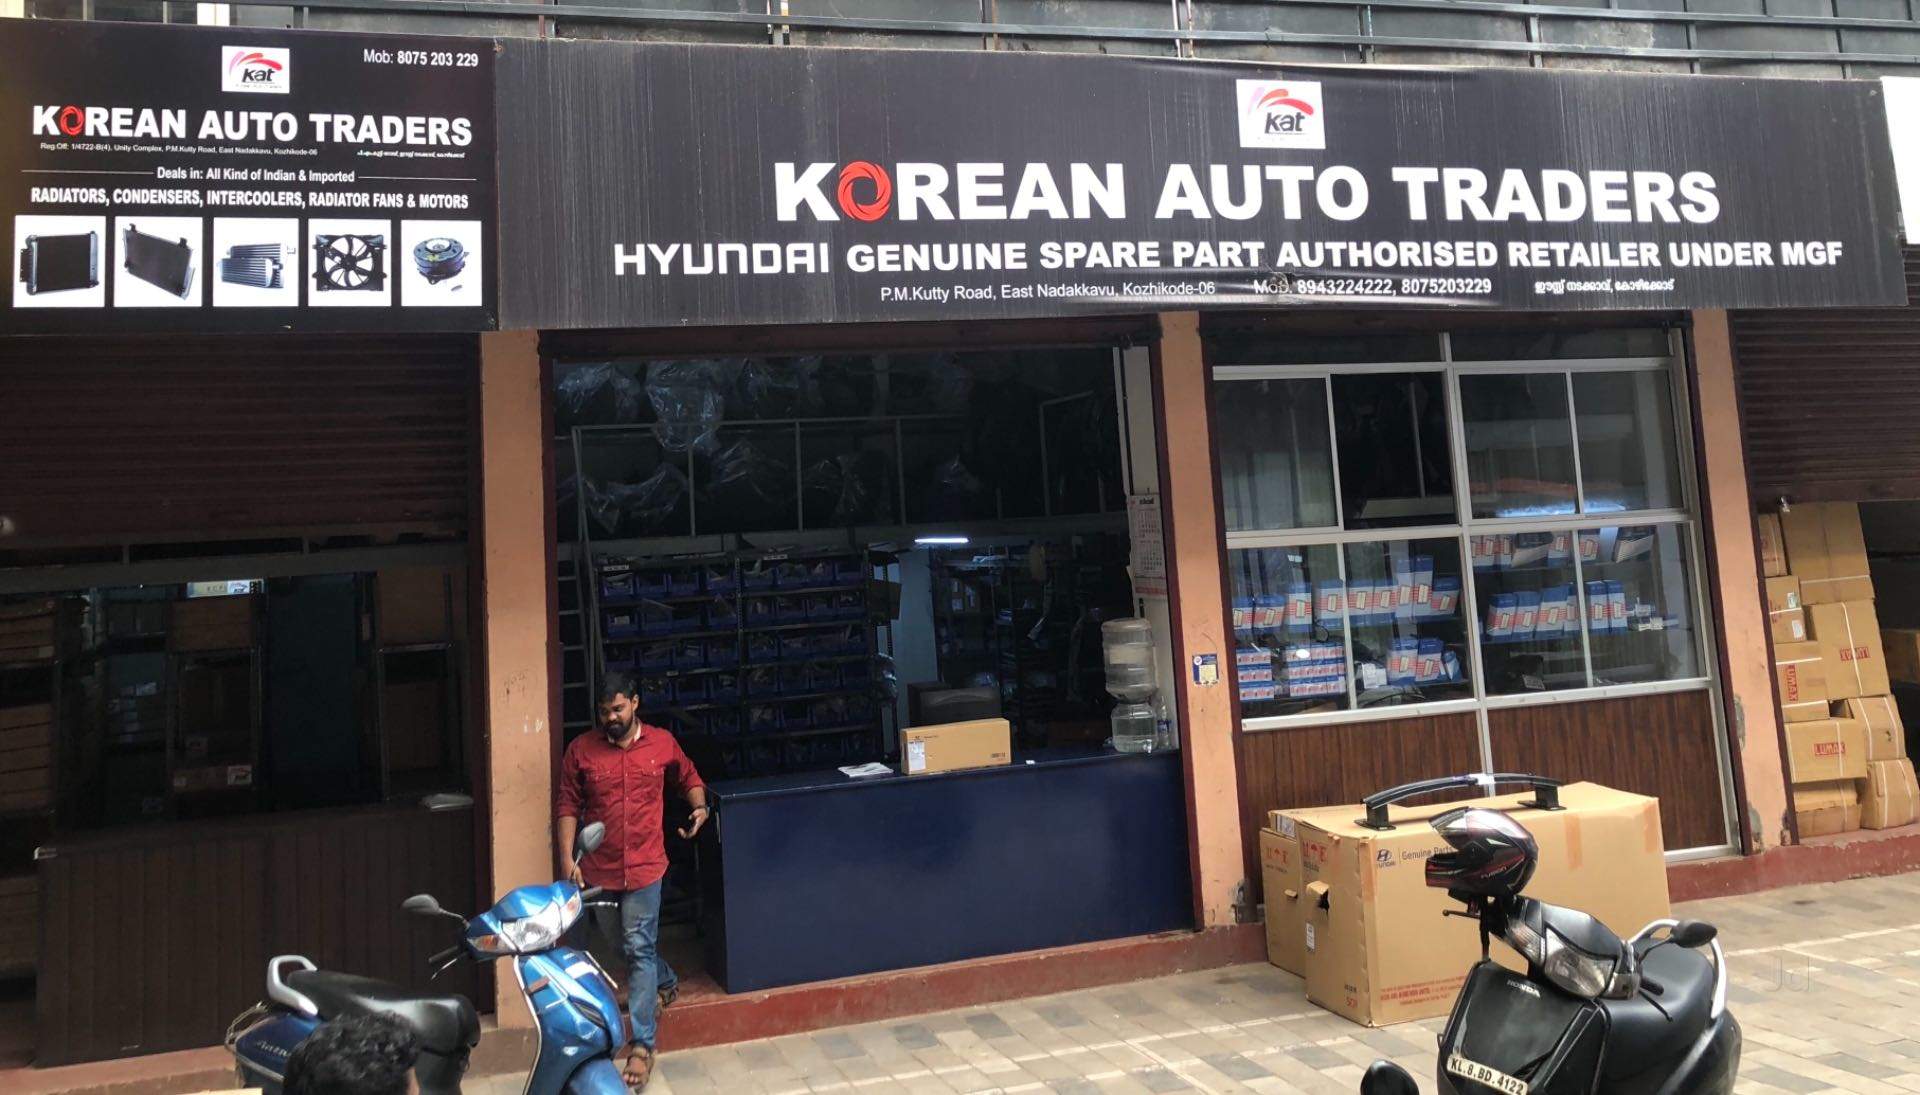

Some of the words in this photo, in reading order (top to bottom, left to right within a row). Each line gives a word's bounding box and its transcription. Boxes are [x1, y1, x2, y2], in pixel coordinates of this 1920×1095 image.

[364, 49, 393, 63] Mob:
[398, 51, 427, 65] 8075
[431, 52, 452, 66] 203
[457, 53, 478, 66] 229
[242, 69, 275, 82] kat
[33, 105, 186, 138] KOREAN
[198, 110, 297, 141] AUTO
[309, 114, 472, 146] TRADERS
[1264, 112, 1305, 134] kat
[114, 144, 131, 153] Unity
[133, 144, 163, 153] Complex,
[158, 167, 187, 179] Deals
[190, 168, 203, 179] in:
[206, 168, 220, 179] All
[224, 168, 248, 180] Kind
[251, 169, 261, 180] of
[264, 170, 295, 180] Indian
[299, 170, 307, 181] &
[309, 170, 354, 184] Imported
[31, 187, 109, 206] RADIATORS,
[113, 189, 203, 207] CONDENSERS,
[207, 191, 305, 209] INTERCOOLERS,
[309, 192, 369, 207] RADIATOR
[373, 193, 403, 207] FANS
[407, 194, 415, 208] &
[419, 194, 468, 208] MOTORS
[775, 161, 1126, 222] KOREAN
[1155, 164, 1368, 220] AUTO
[1392, 167, 1719, 223] TRADERS
[615, 243, 829, 275] HYUNDAI
[847, 243, 1027, 272] GENUINE
[1040, 242, 1160, 268] SPARE
[1172, 241, 1265, 268] PART
[1276, 241, 1497, 267] AUTHORISED
[1508, 242, 1661, 267] RETAILER
[1669, 242, 1774, 266] UNDER
[1781, 241, 1842, 265] MGF
[881, 287, 949, 303] P.M.Kutty
[955, 285, 996, 300] Road,
[1001, 285, 1033, 299] East
[1037, 283, 1119, 298] Nadakkavu,
[1123, 281, 1215, 296] Kozhikode-06
[1297, 279, 1396, 296] 8943224222,
[1402, 278, 1491, 293] 8075203229
